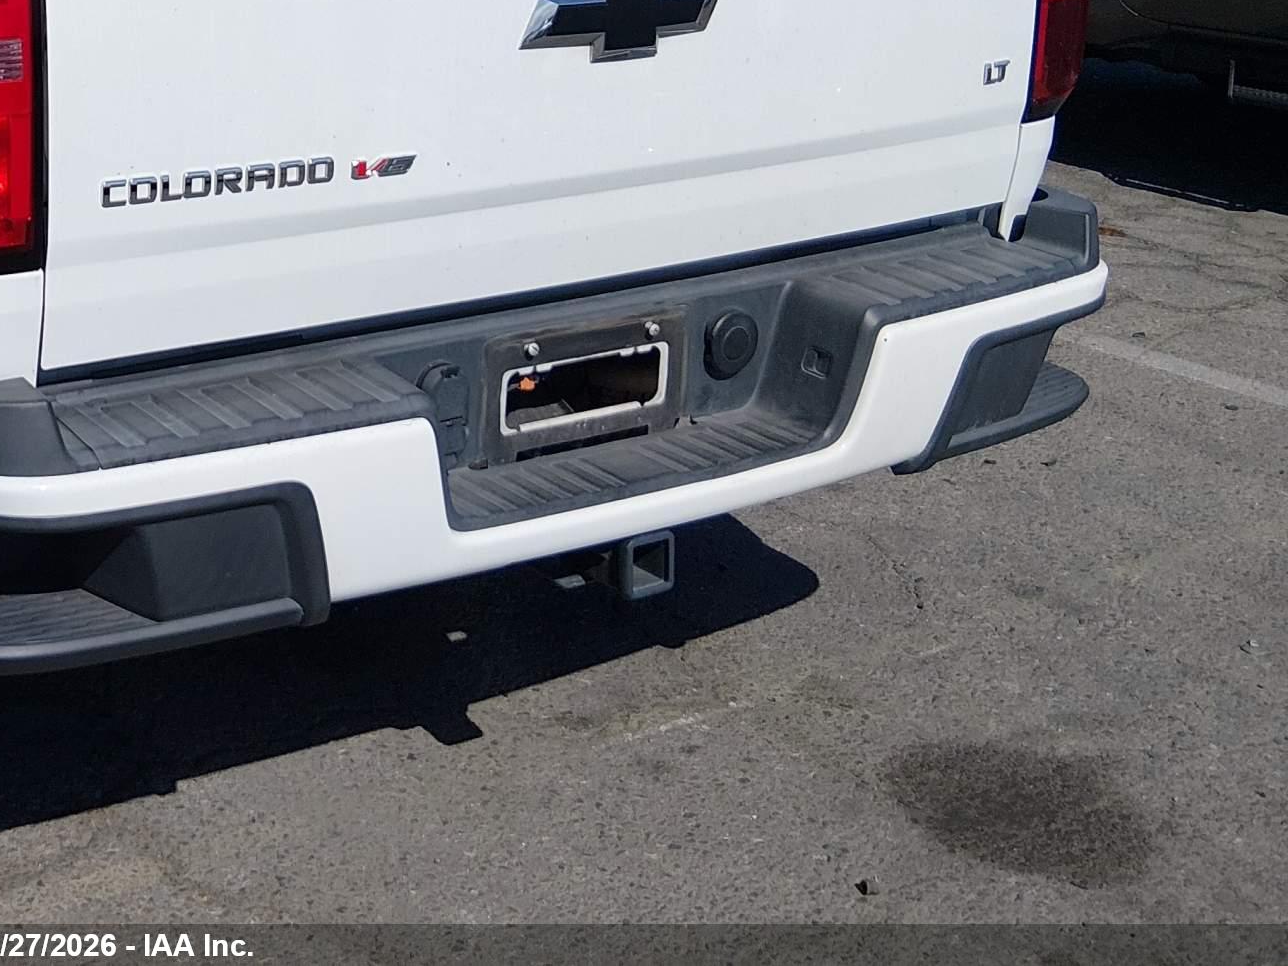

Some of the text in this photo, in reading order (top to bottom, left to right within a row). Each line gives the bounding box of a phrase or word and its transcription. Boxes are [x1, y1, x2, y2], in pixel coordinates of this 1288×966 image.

[983, 59, 1011, 85] LT
[101, 154, 417, 208] COLORADO V6
